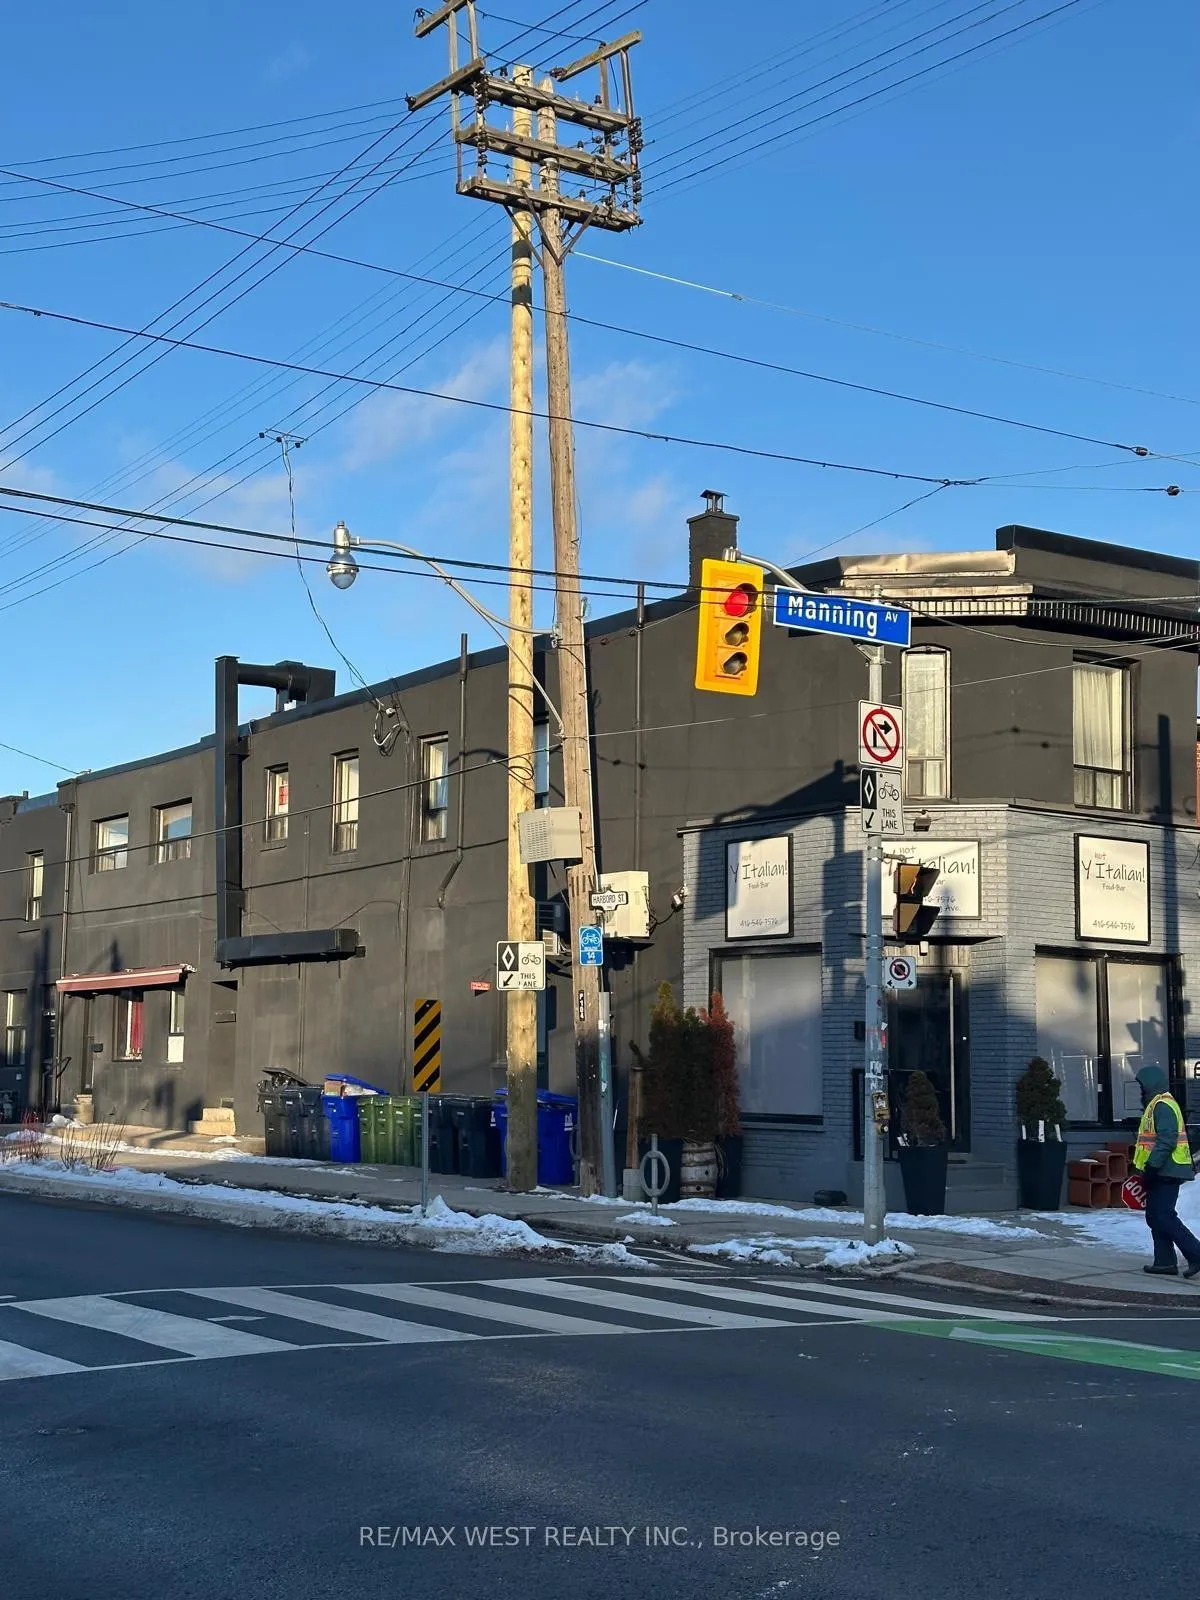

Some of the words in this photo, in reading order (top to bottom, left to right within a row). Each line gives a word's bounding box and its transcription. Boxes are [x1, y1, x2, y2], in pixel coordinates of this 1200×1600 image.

[788, 595, 878, 637] Manning
[885, 611, 898, 623] Av
[881, 808, 896, 818] THIS
[881, 820, 898, 831] LANE
[729, 863, 739, 883] Y
[741, 859, 788, 880] Italian!
[918, 855, 976, 875] talian!
[1081, 860, 1092, 880] Y
[1095, 863, 1146, 883] Italian!
[593, 895, 616, 905] HARBORD
[521, 972, 536, 980] THIS
